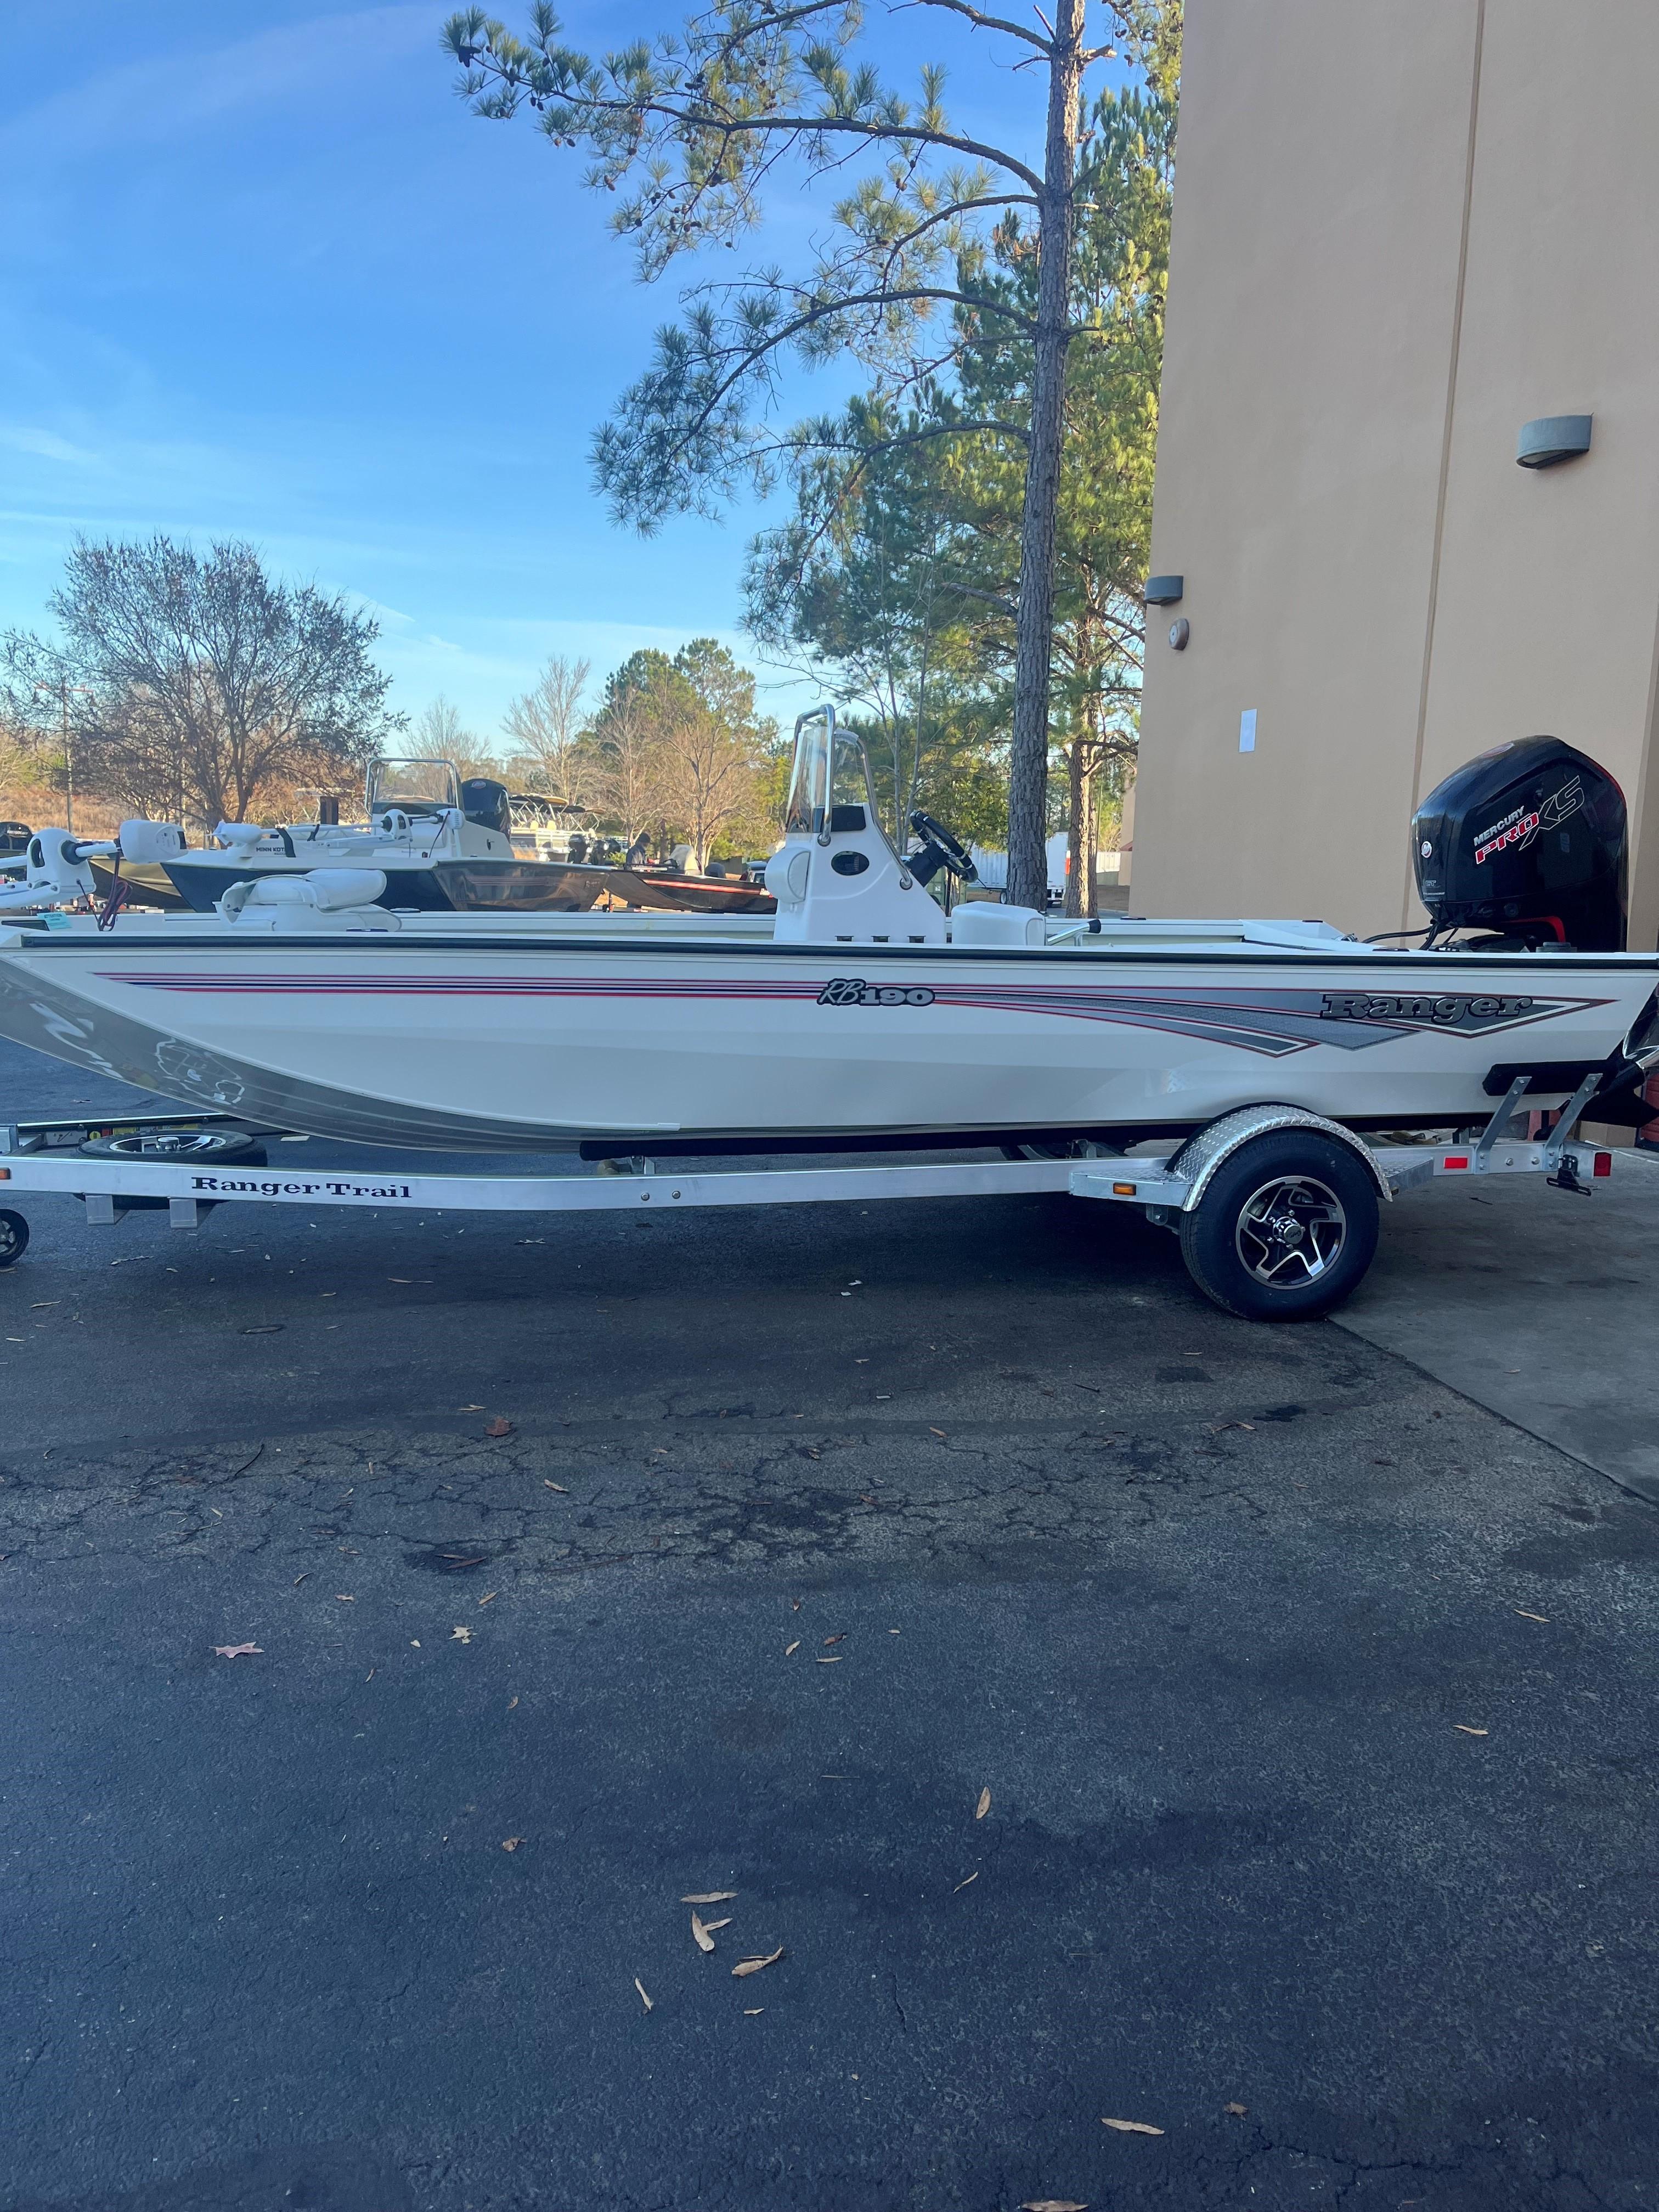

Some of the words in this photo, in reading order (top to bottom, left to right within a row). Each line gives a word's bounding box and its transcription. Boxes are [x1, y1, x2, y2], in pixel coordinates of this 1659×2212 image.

[1474, 805, 1525, 847] MERCURY
[1475, 812, 1539, 865] PRO
[1320, 994, 1533, 1025] Ranger
[191, 1177, 320, 1197] Ranger
[326, 1183, 413, 1198] Trail
